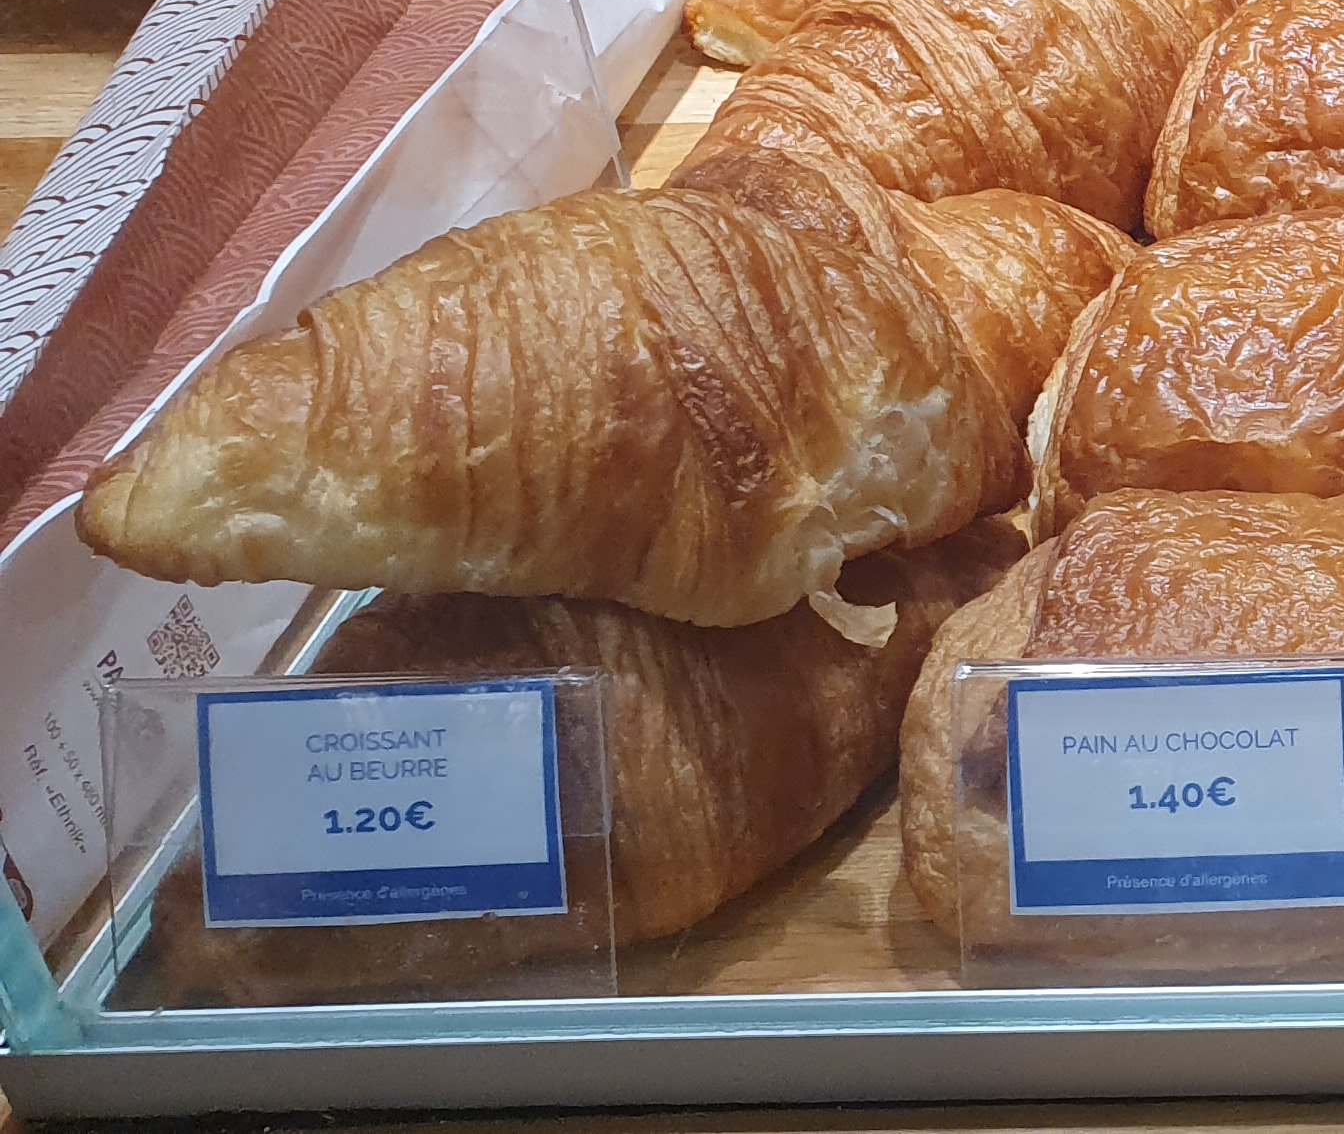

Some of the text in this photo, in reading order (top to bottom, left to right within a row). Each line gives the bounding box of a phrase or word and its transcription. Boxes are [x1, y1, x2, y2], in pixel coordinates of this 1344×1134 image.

[305, 728, 448, 754] CROISSANT
[1062, 727, 1300, 755] PAIN AU CHOCOLAT
[306, 757, 448, 784] AU BEURRE
[1127, 776, 1237, 815] 1.40€
[322, 799, 436, 835] 1.20€
